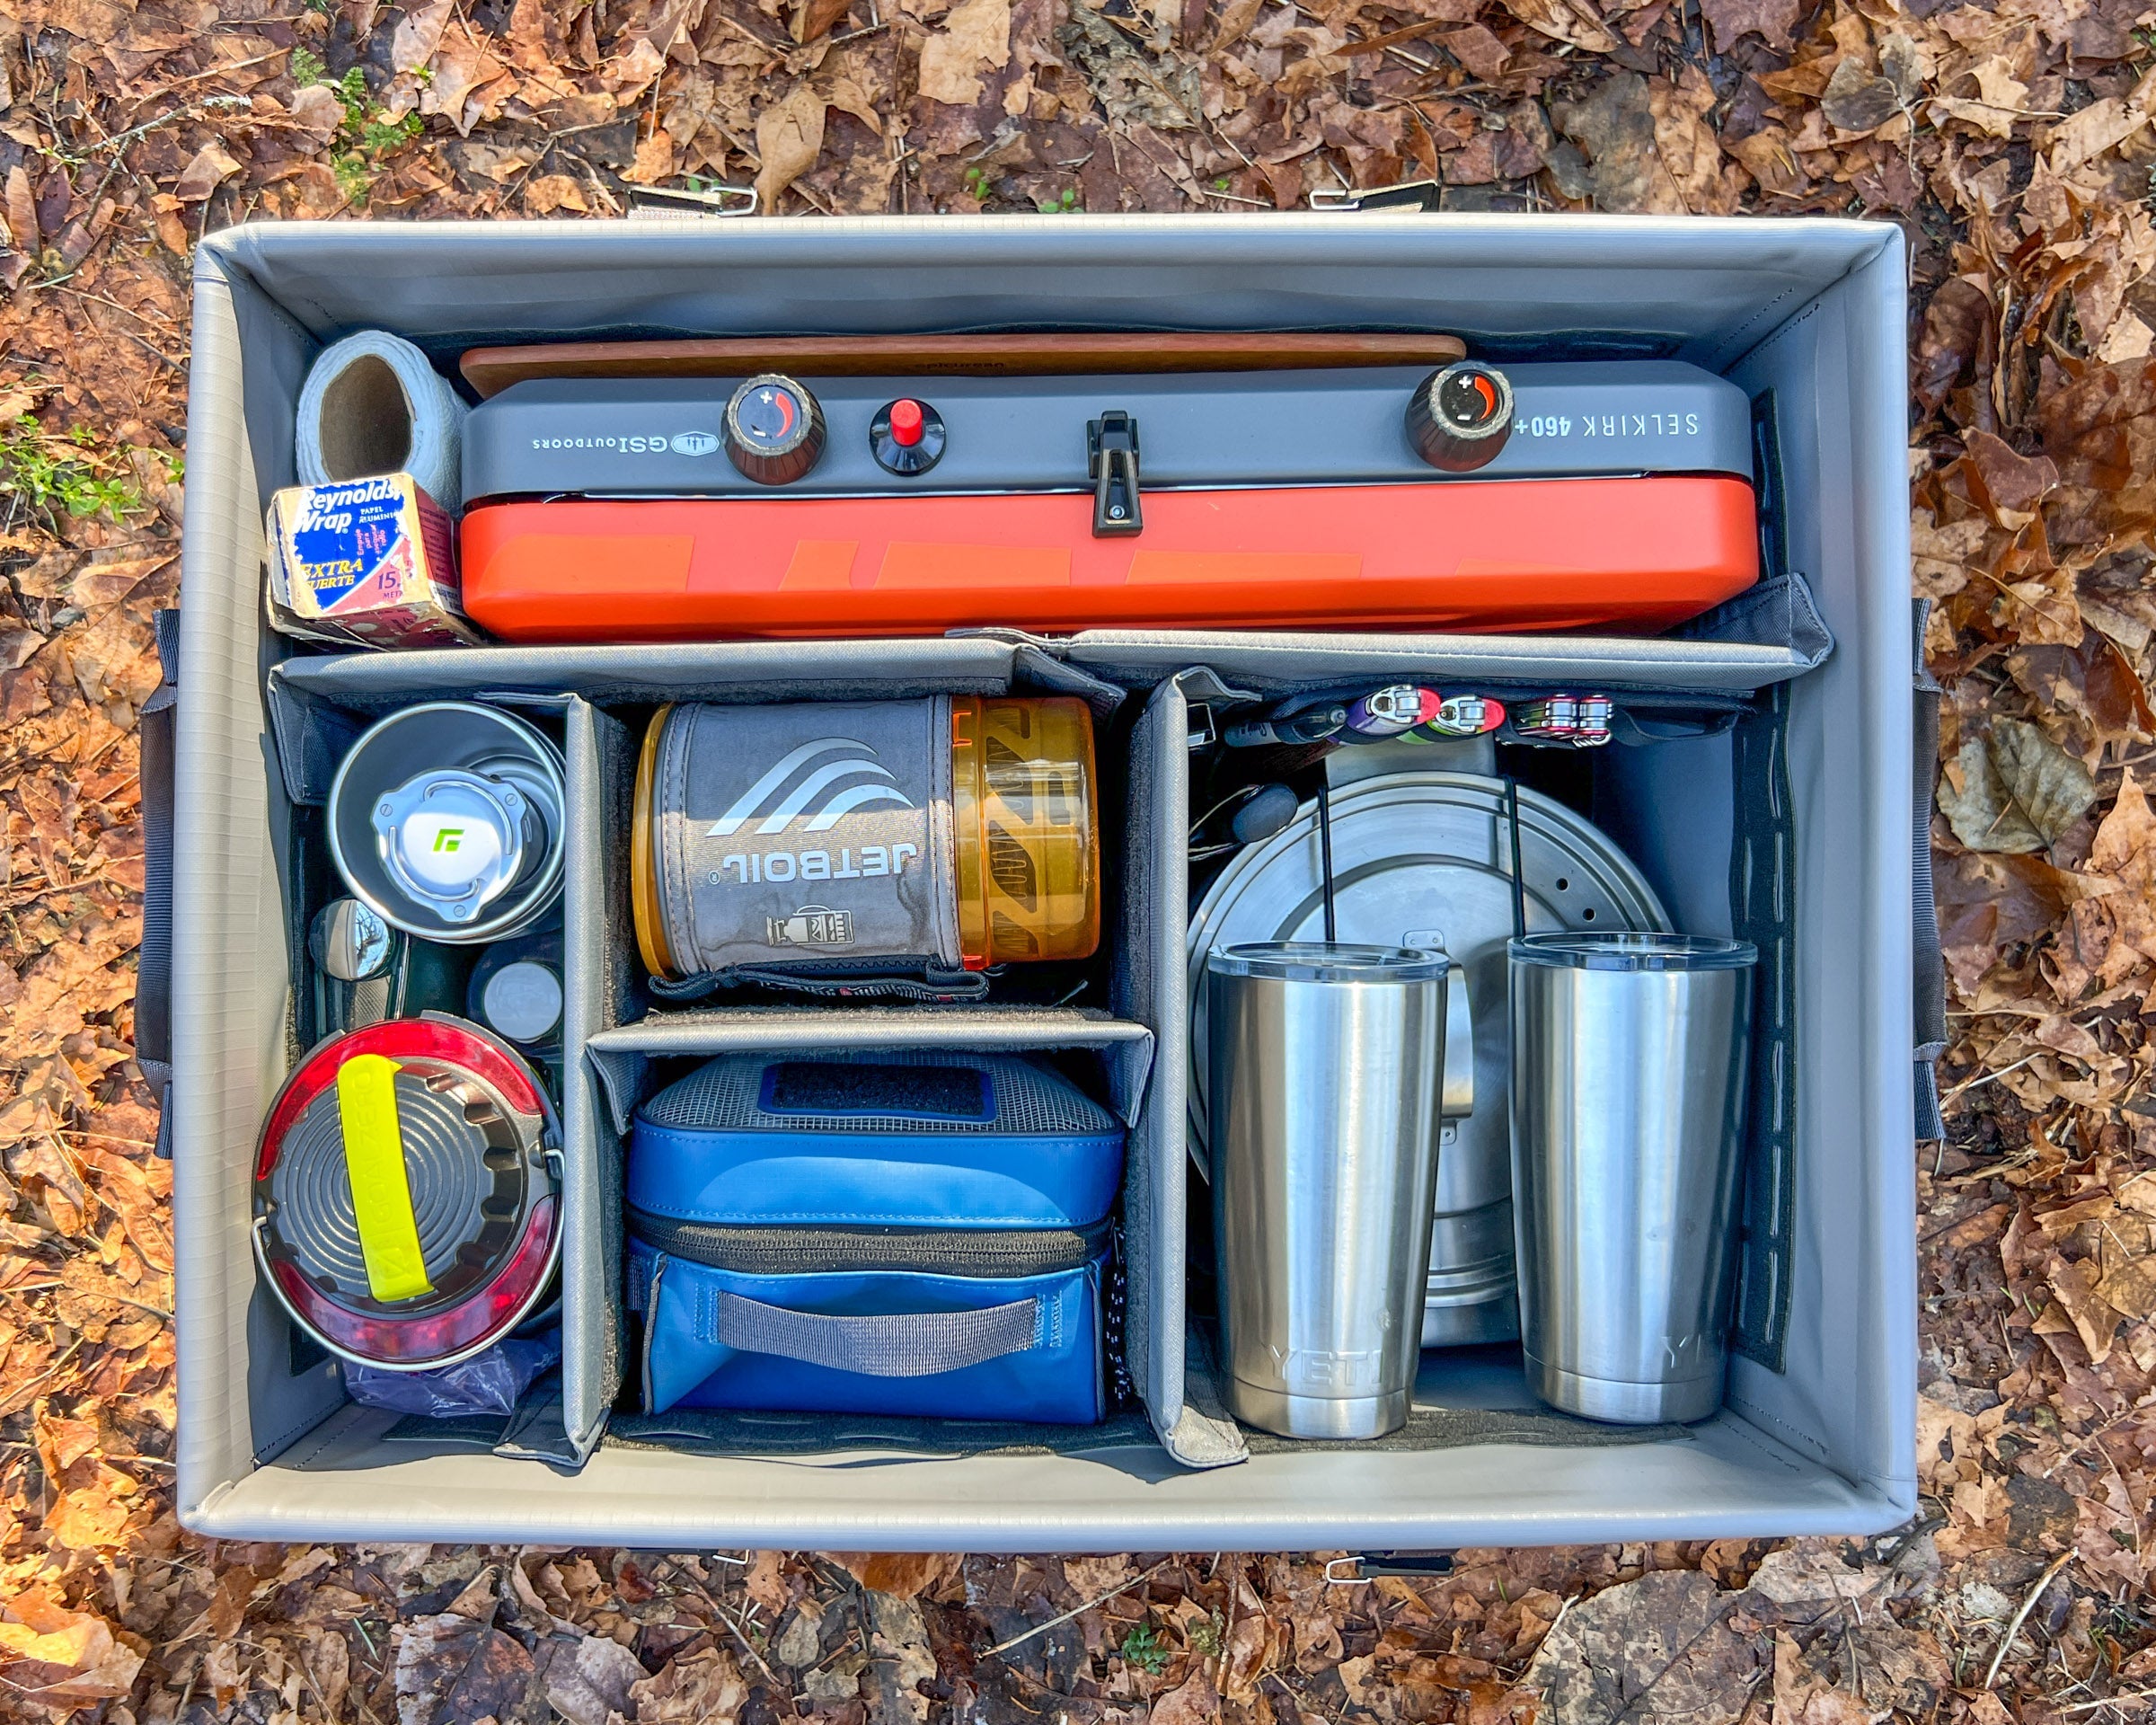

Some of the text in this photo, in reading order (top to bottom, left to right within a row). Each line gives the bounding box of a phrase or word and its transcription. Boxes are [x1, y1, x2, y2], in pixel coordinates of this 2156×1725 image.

[1515, 413, 1699, 438] SELKIRK 460+
[532, 436, 668, 453] GSI OUTDOORS
[299, 479, 400, 514] Reynolds
[295, 509, 352, 535] Wrap
[360, 506, 384, 516] PAPEL
[300, 558, 364, 579] EXTRA
[308, 575, 356, 590] UERTE
[378, 571, 401, 590] 15.
[722, 843, 917, 884] JETBOIL
[1260, 1342, 1383, 1385] YETI
